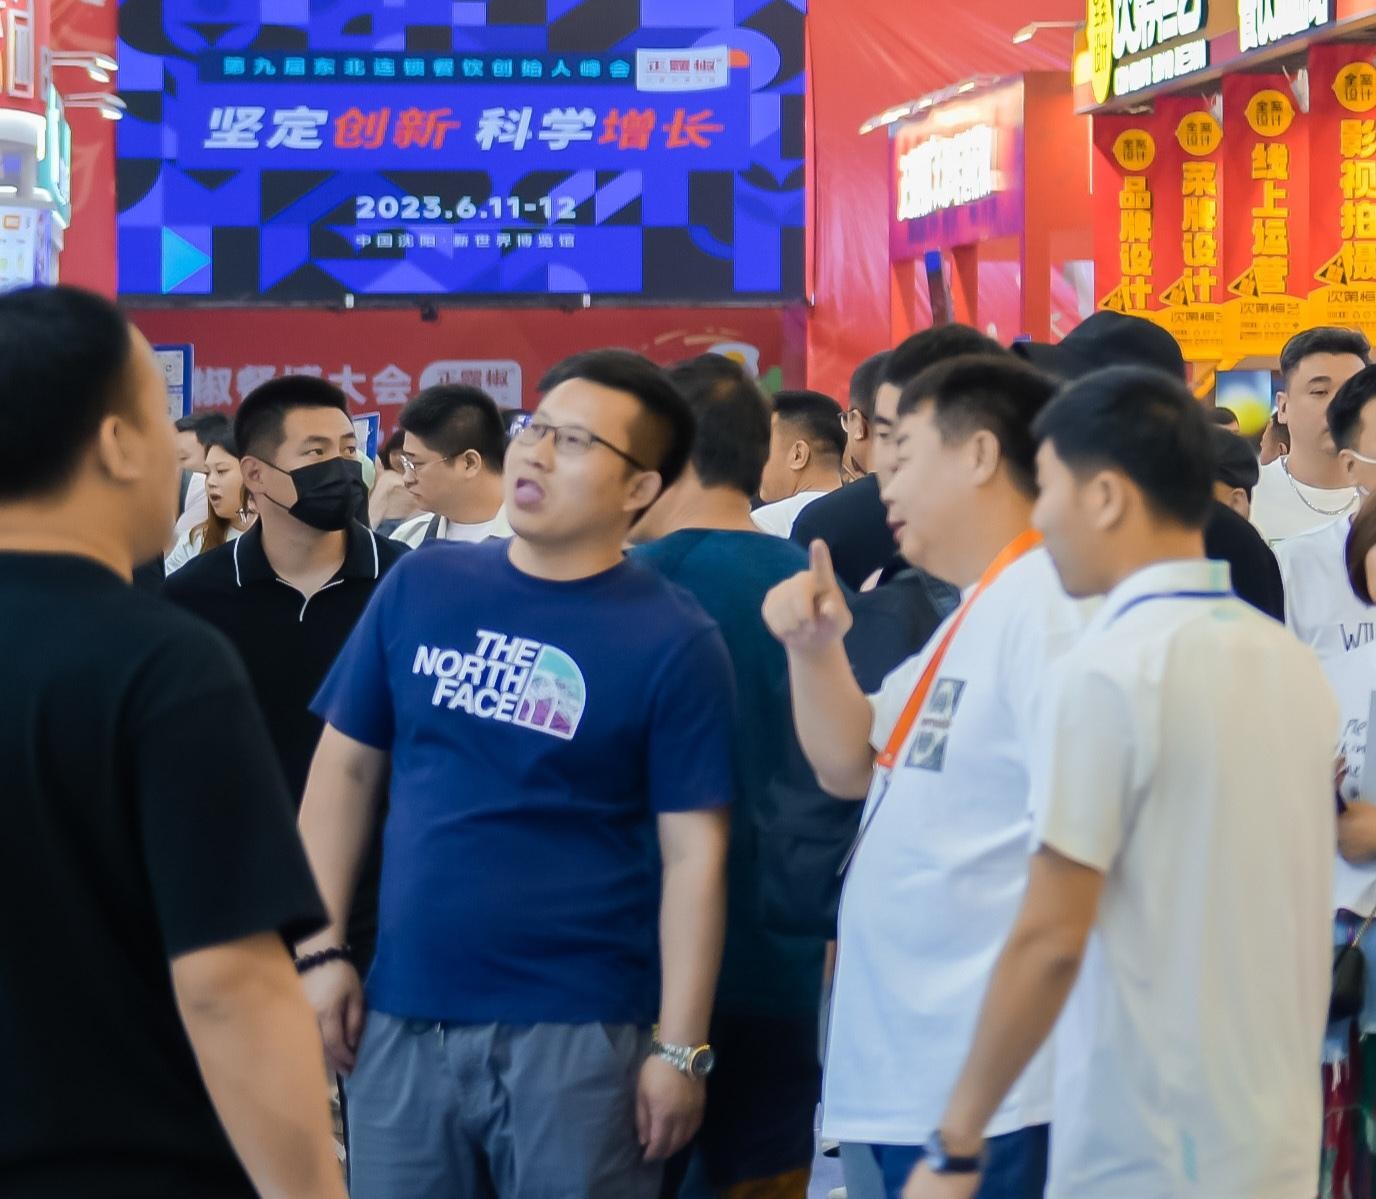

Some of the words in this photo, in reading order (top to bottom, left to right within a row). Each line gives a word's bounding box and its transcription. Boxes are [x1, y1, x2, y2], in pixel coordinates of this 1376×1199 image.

[204, 105, 461, 150] 坚定创新
[475, 105, 724, 151] 科学增长
[355, 195, 577, 220] 2023.6.11-12
[1251, 143, 1290, 295] 线上运营
[413, 644, 532, 694] NORTH
[475, 628, 540, 669] THE
[431, 676, 521, 724] FACE
